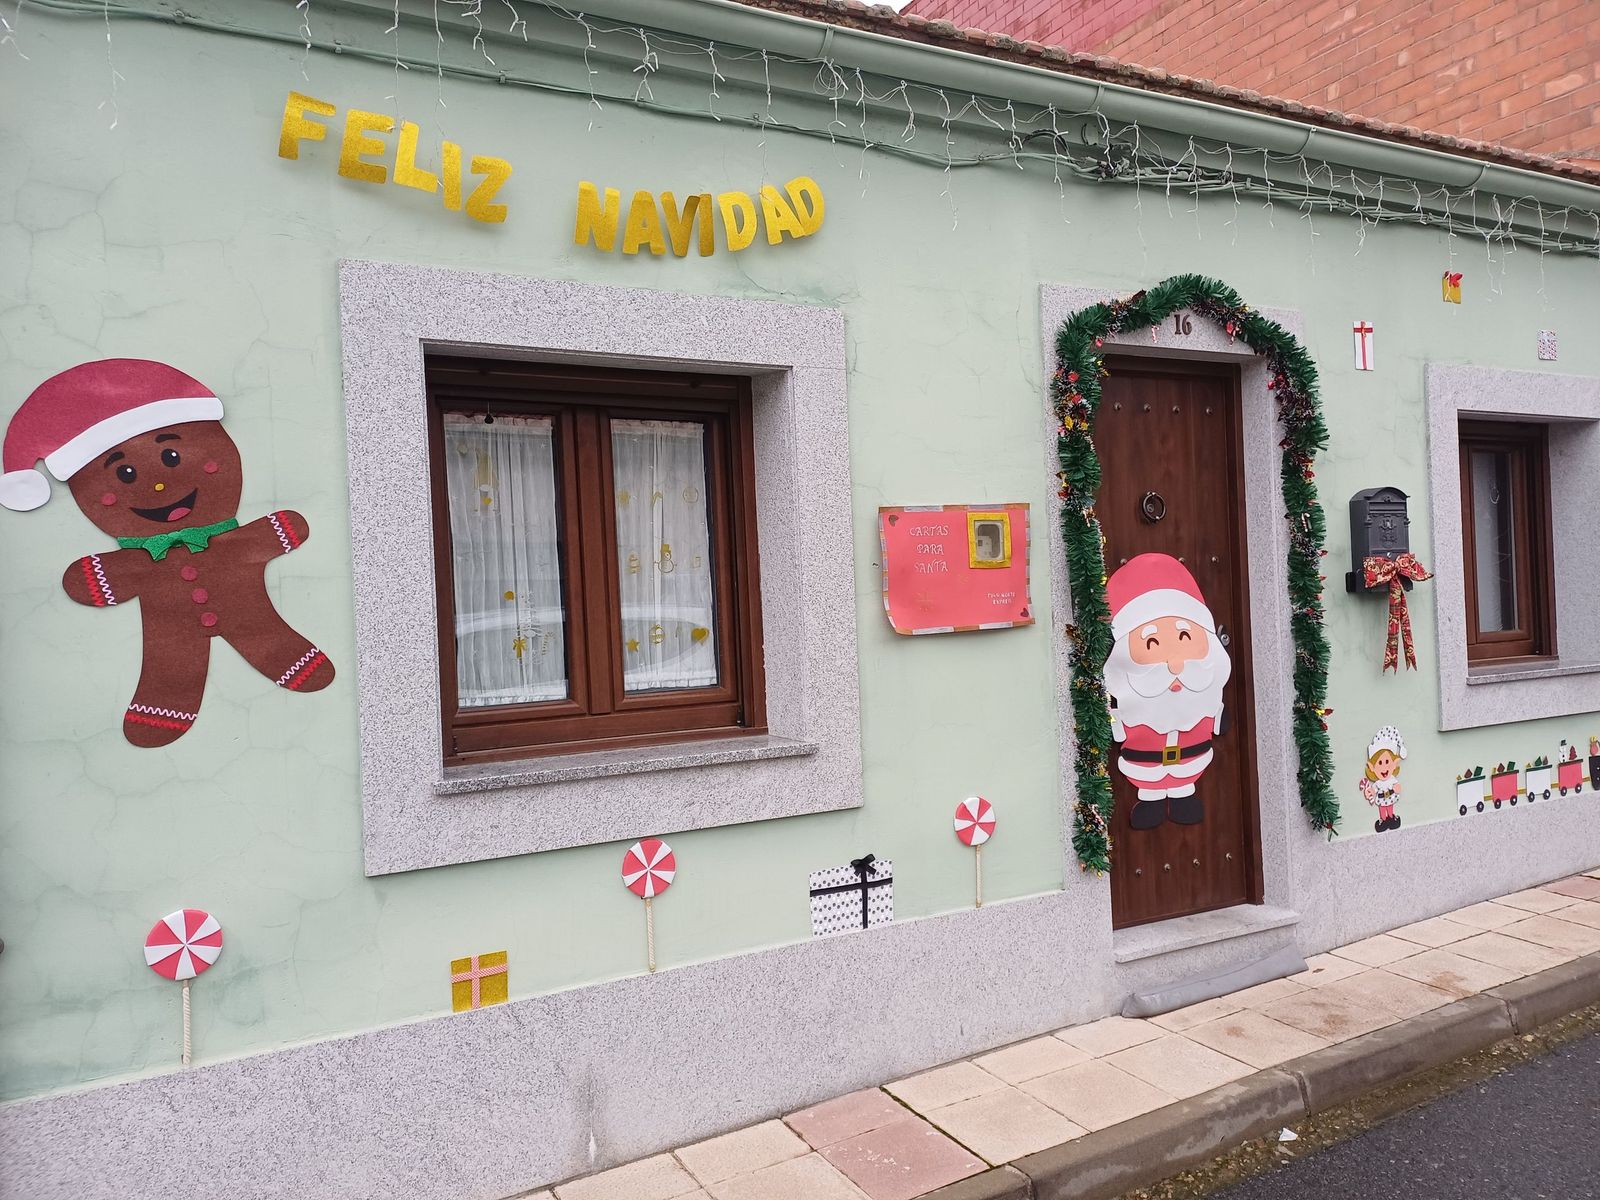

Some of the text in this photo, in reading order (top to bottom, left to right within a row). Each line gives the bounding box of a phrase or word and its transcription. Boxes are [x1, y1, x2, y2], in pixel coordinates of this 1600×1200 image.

[277, 90, 826, 258] FELIZ NAVIDAD
[1174, 314, 1193, 336] 16
[909, 524, 949, 537] CARTAS
[916, 543, 945, 556] PARA
[913, 558, 949, 574] SANTA
